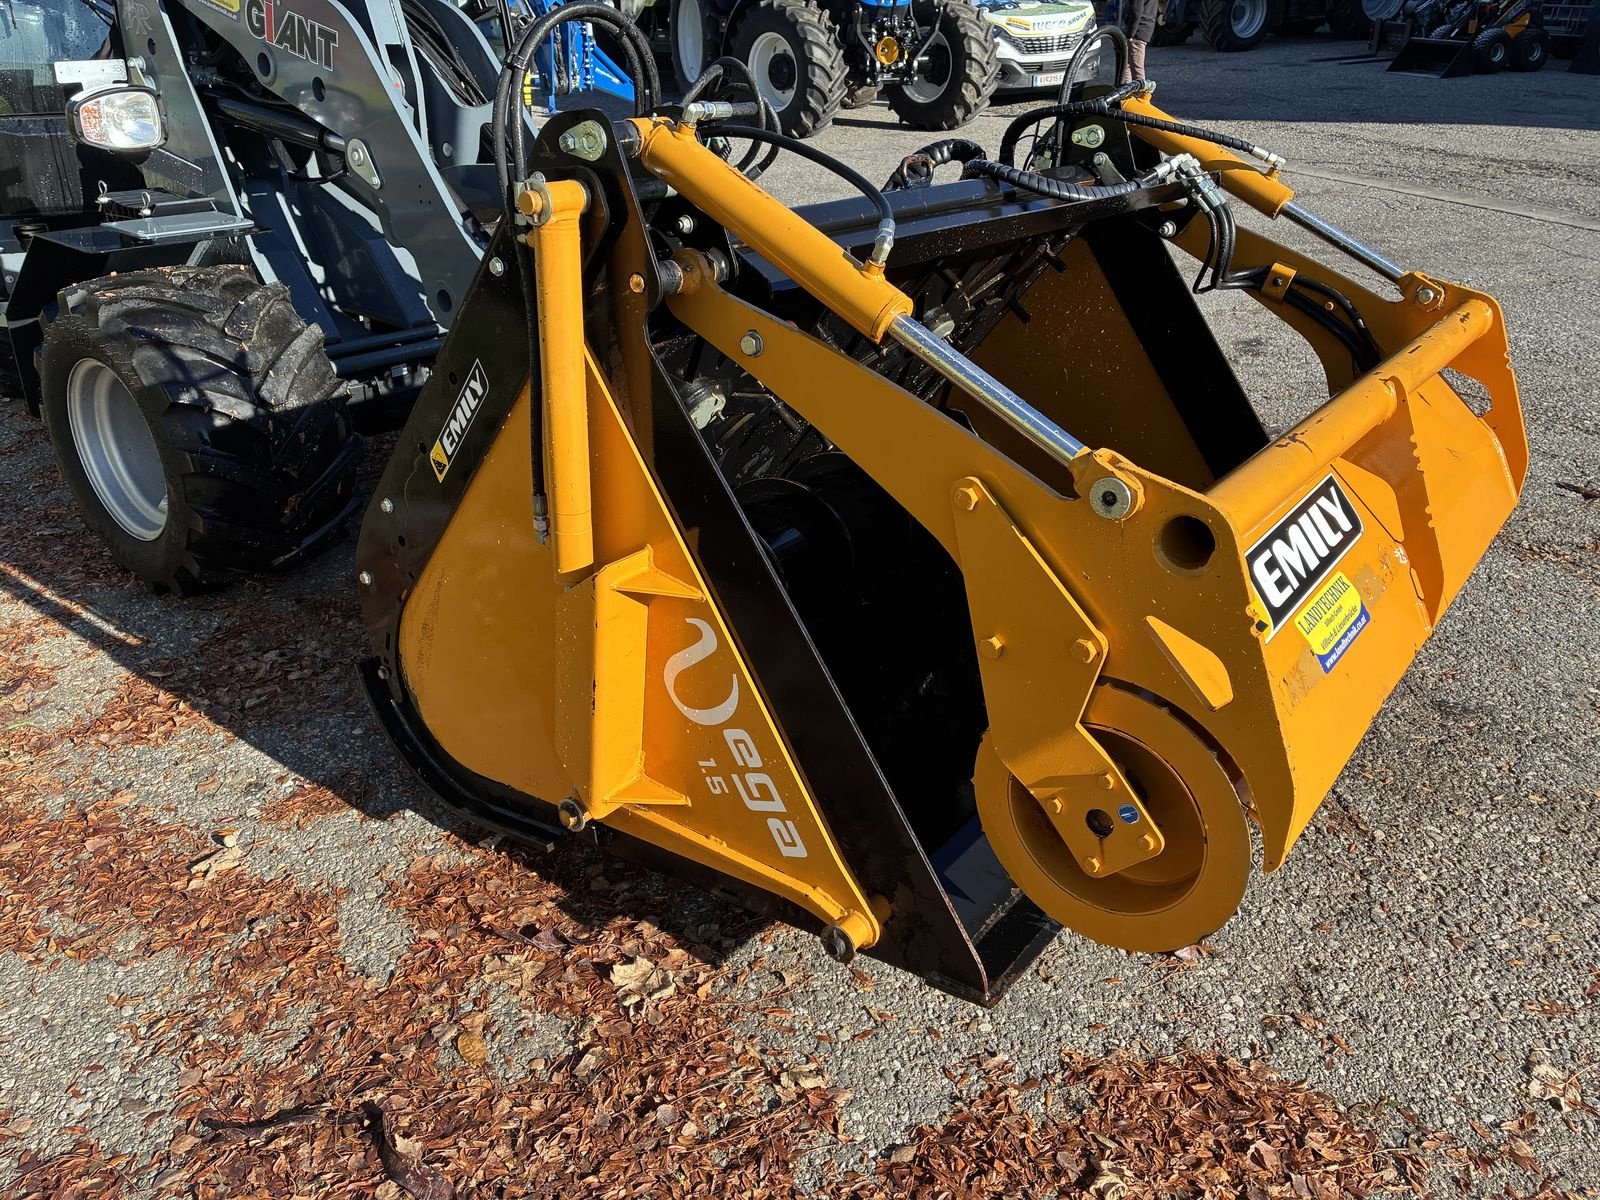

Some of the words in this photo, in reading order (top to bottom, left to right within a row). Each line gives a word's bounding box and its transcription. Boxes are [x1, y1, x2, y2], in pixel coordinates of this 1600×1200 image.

[442, 369, 484, 456] EMILY
[1253, 486, 1353, 608] EMILY
[1298, 575, 1351, 635] LANDTECHNIK
[1325, 614, 1367, 669] www.landtechnik.co.at
[697, 757, 730, 796] 1.5
